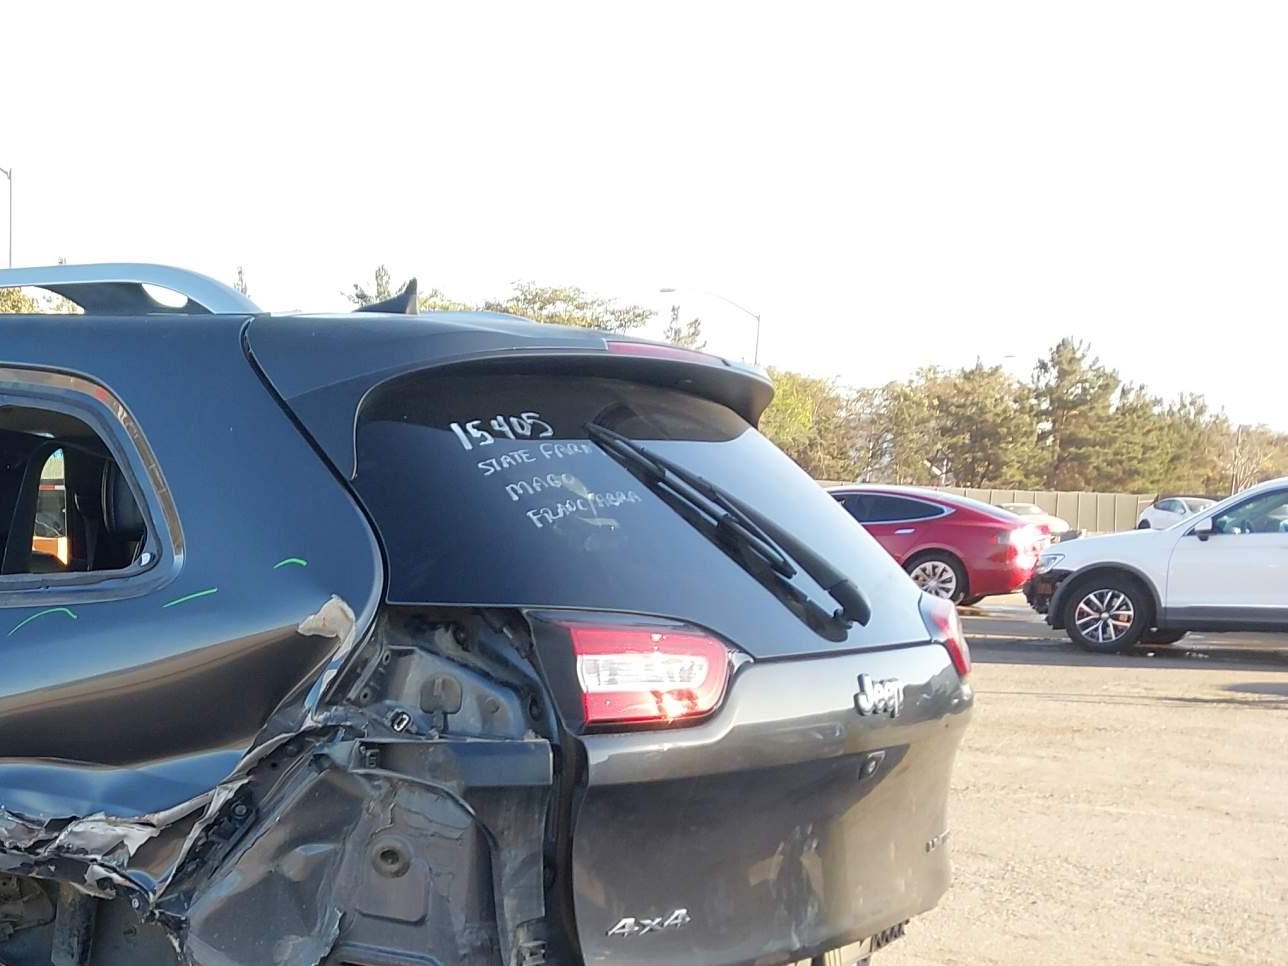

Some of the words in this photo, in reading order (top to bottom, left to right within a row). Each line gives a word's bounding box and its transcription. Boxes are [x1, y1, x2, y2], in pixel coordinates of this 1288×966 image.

[450, 412, 554, 450] 15405
[477, 449, 537, 476] STATE
[853, 672, 904, 718] Jeep
